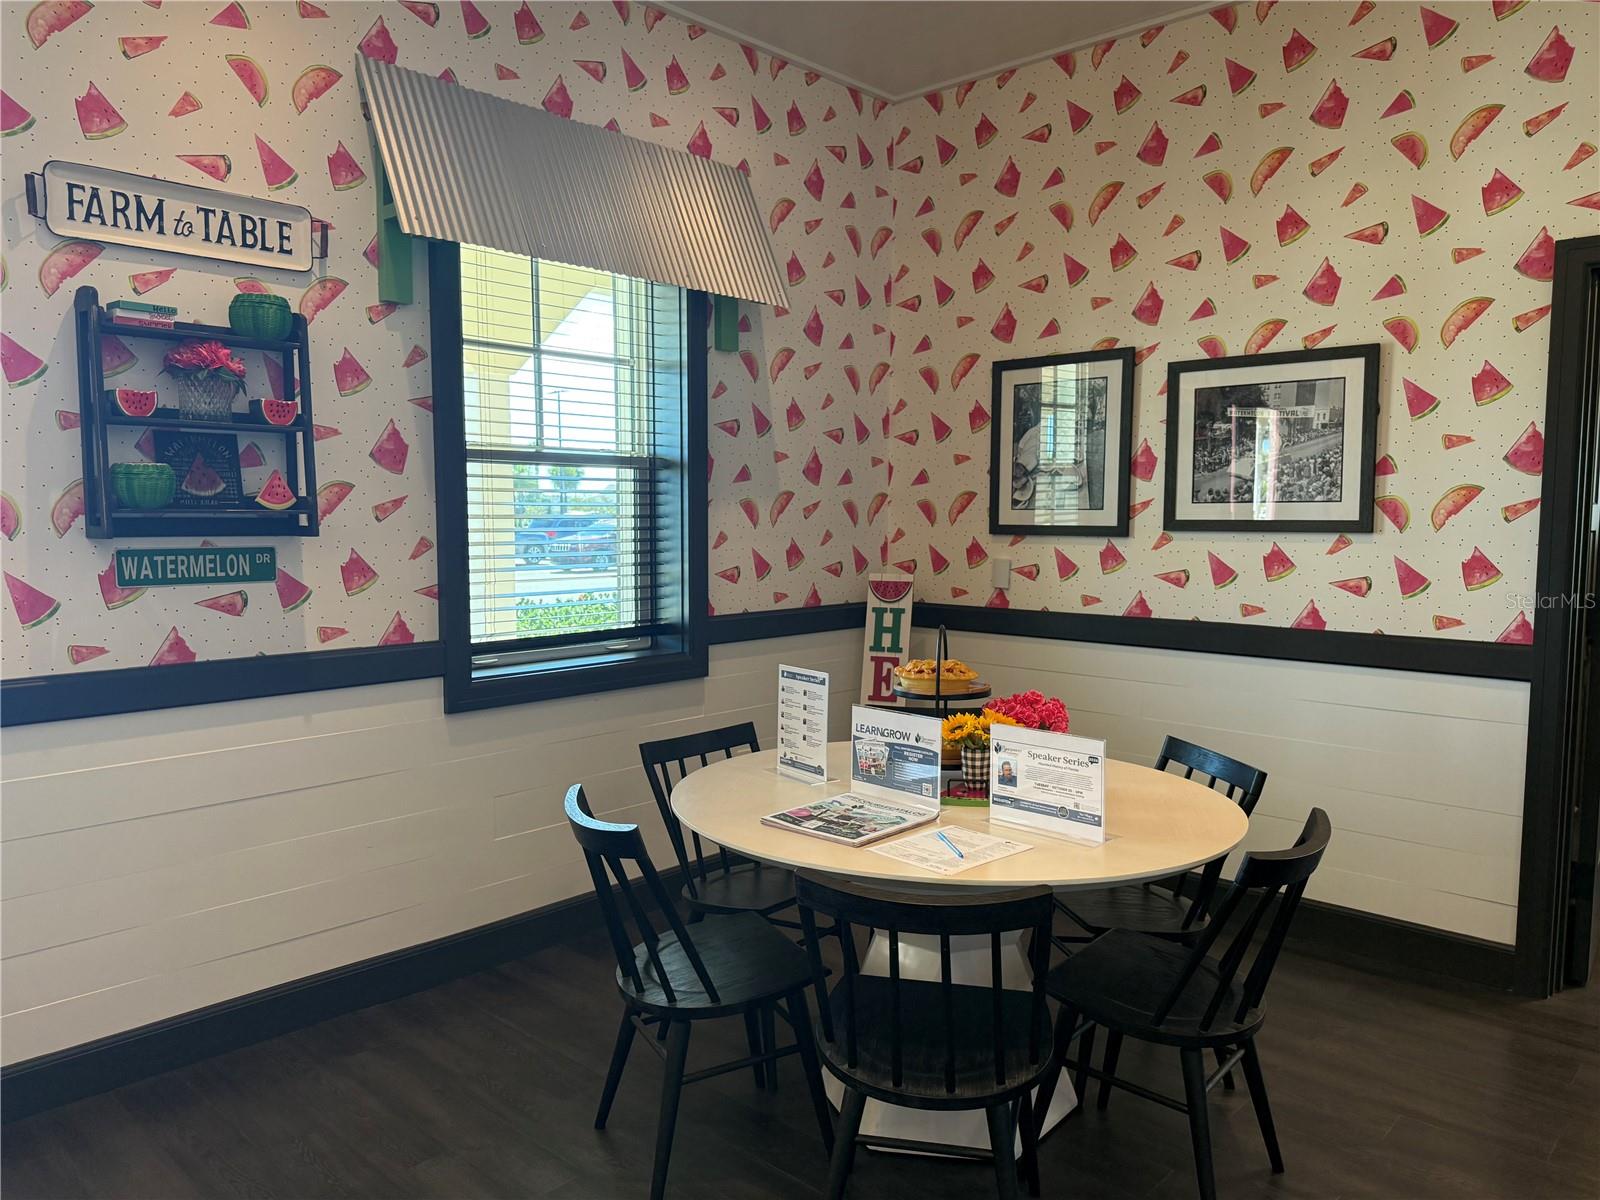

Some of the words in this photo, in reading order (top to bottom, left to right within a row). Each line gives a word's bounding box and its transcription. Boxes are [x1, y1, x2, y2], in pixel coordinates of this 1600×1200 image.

[66, 182, 167, 236] FARM
[174, 210, 194, 238] to
[197, 205, 293, 255] TABLE
[121, 554, 250, 580] WATERMELON
[256, 553, 271, 564] DR
[1028, 750, 1062, 763] Speaker
[1063, 756, 1090, 769] Series
